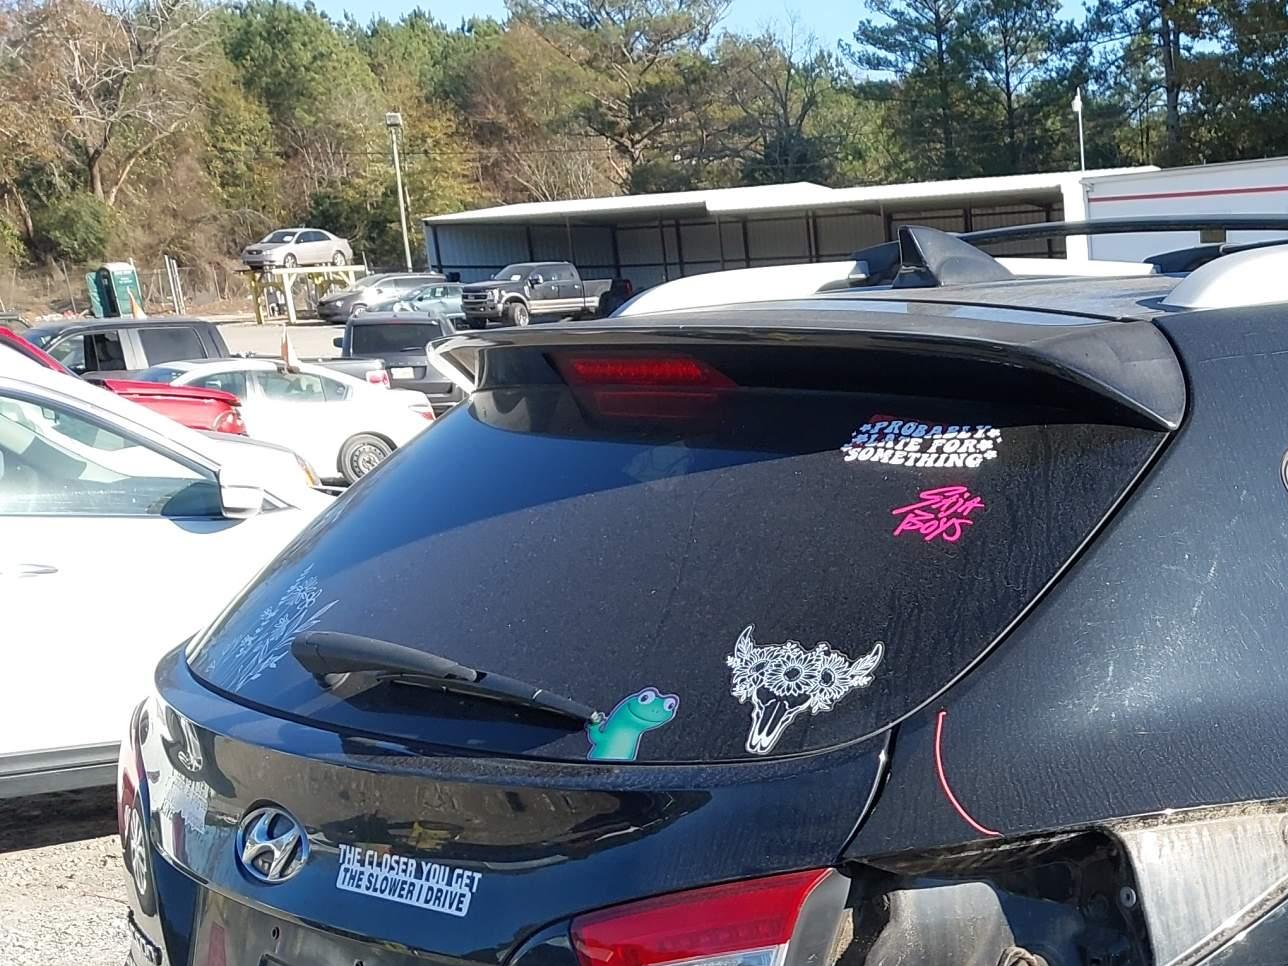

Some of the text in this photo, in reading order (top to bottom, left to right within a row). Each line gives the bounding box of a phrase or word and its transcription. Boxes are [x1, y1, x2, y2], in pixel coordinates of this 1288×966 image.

[870, 420, 991, 439] PROBABLY
[864, 434, 977, 453] LATE FOR
[844, 447, 983, 468] SOMETHING
[338, 844, 482, 893] THE CLOSER YOU GET
[342, 867, 467, 912] THE SLOWER I DRIVE
